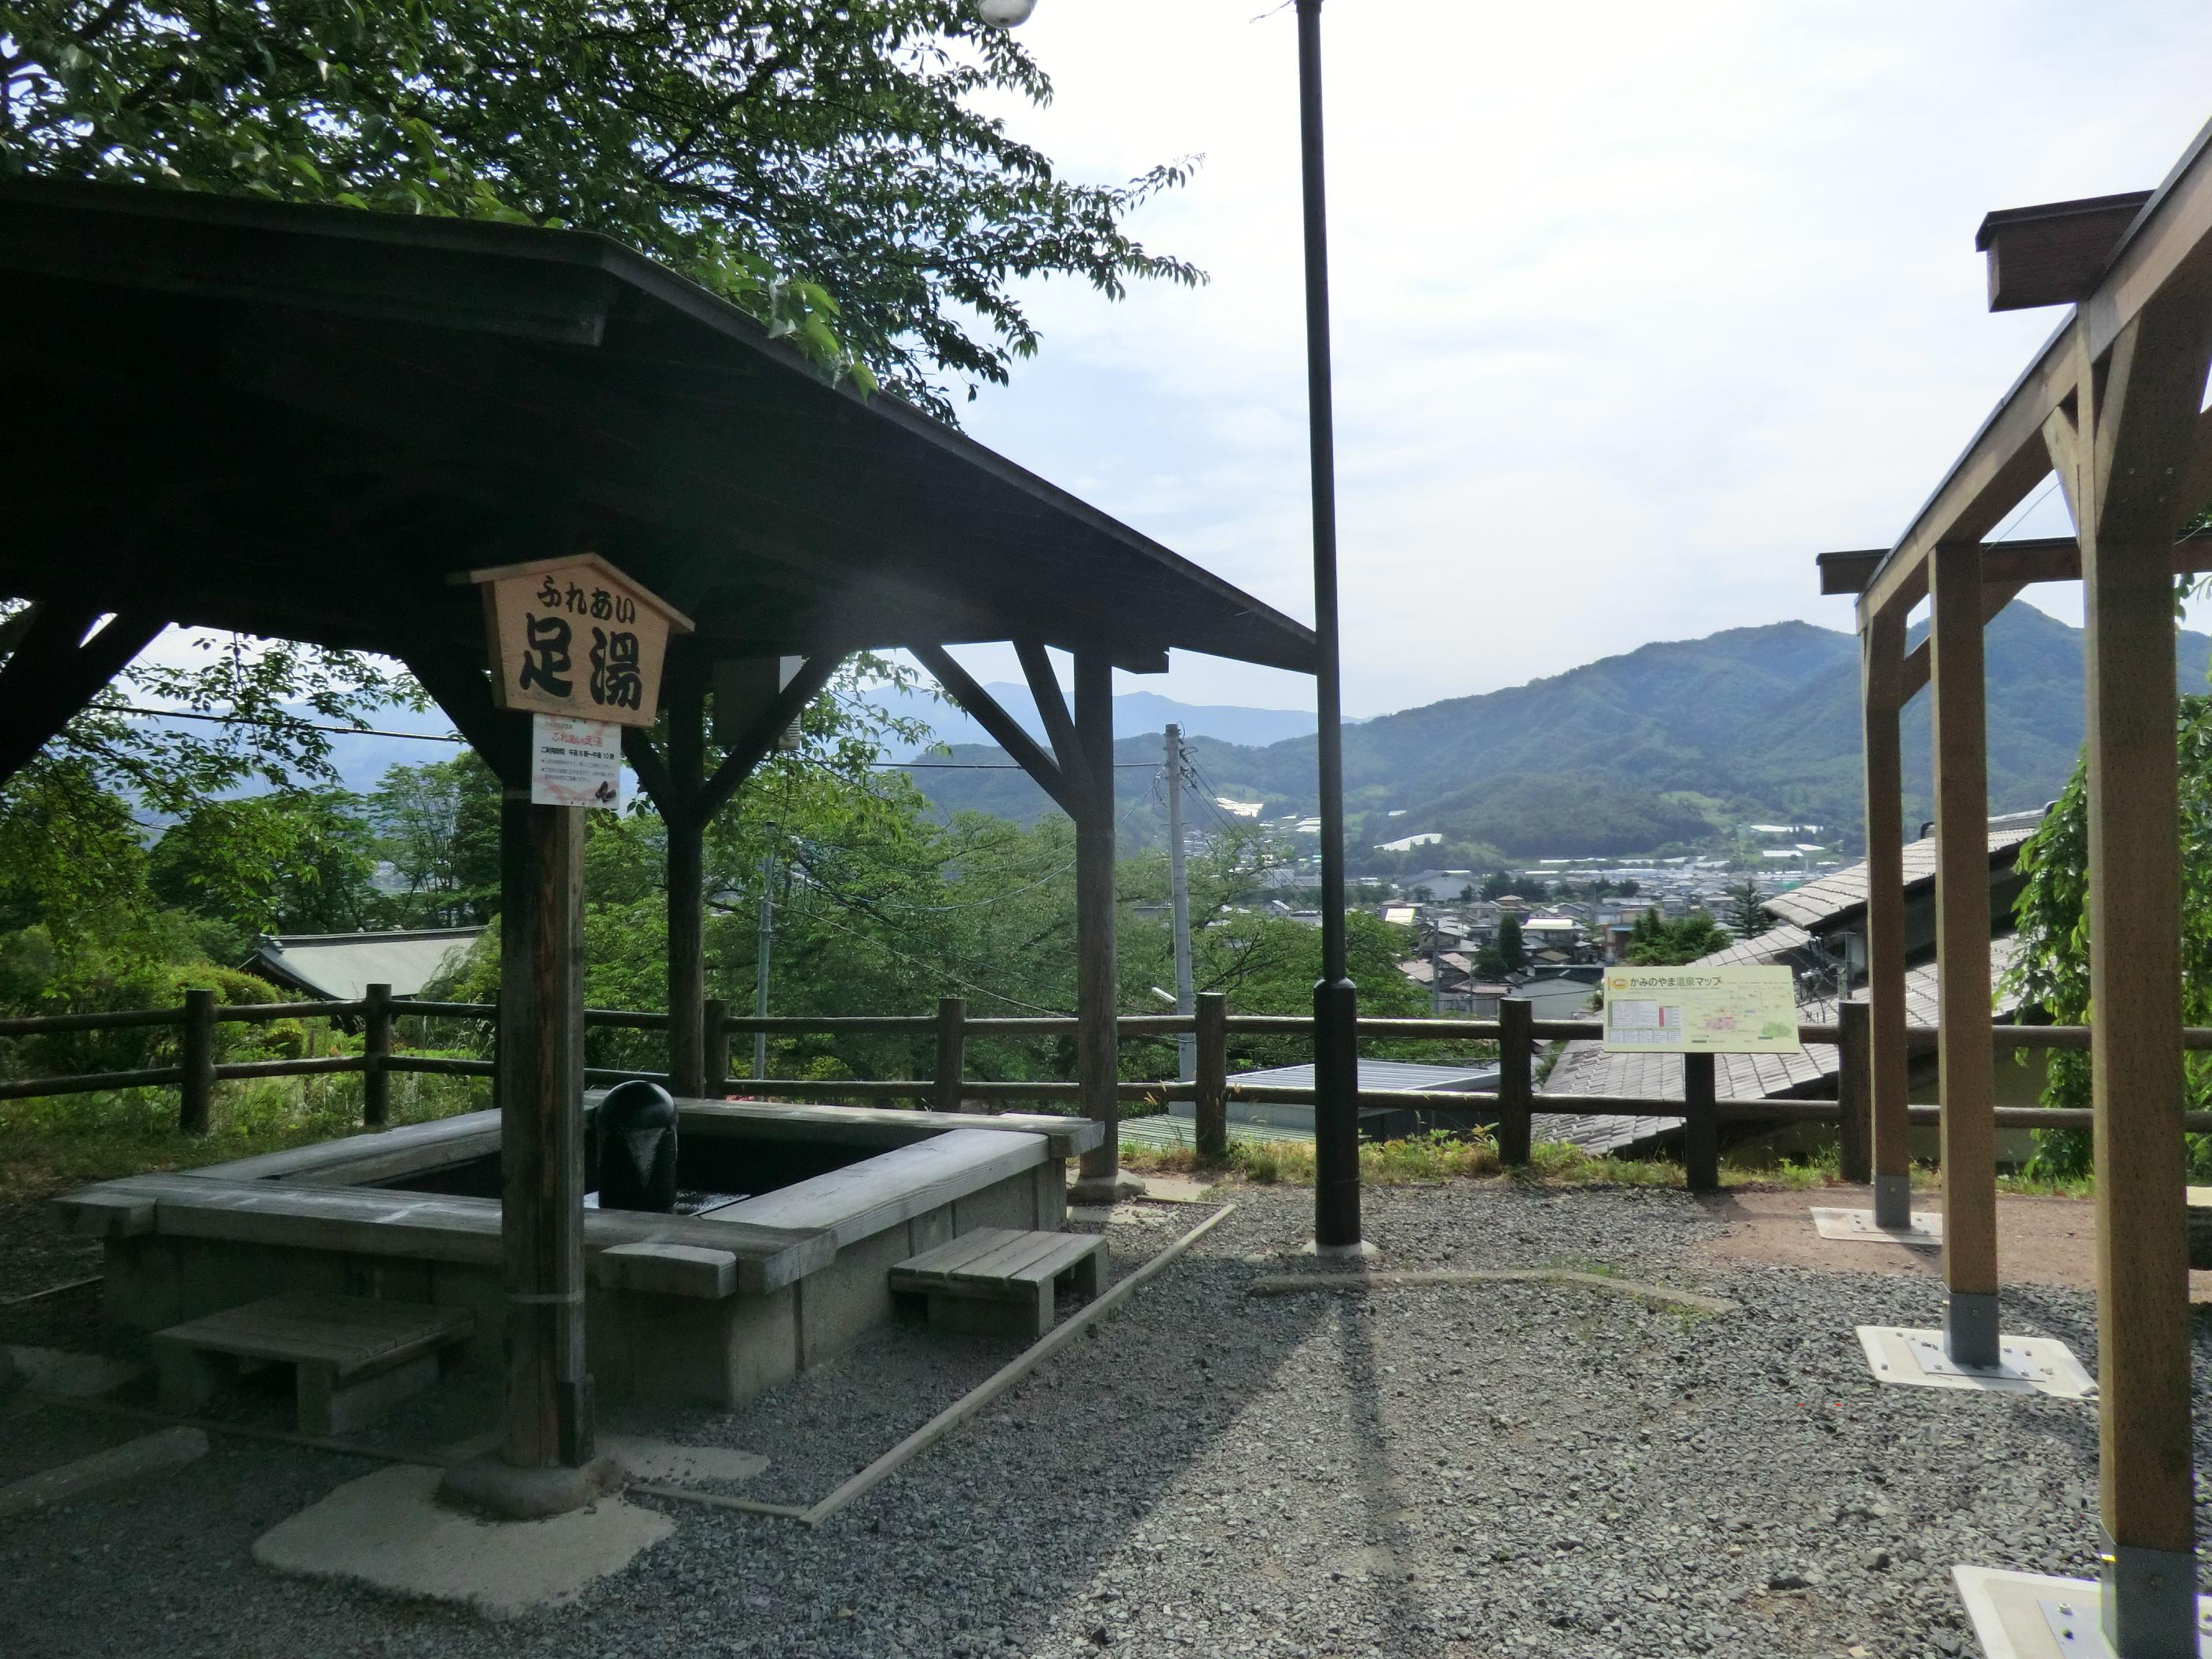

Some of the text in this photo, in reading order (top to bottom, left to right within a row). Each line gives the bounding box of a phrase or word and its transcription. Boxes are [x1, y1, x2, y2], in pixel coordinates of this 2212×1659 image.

[537, 575, 635, 623] ふれあい
[519, 612, 642, 711] 足湯
